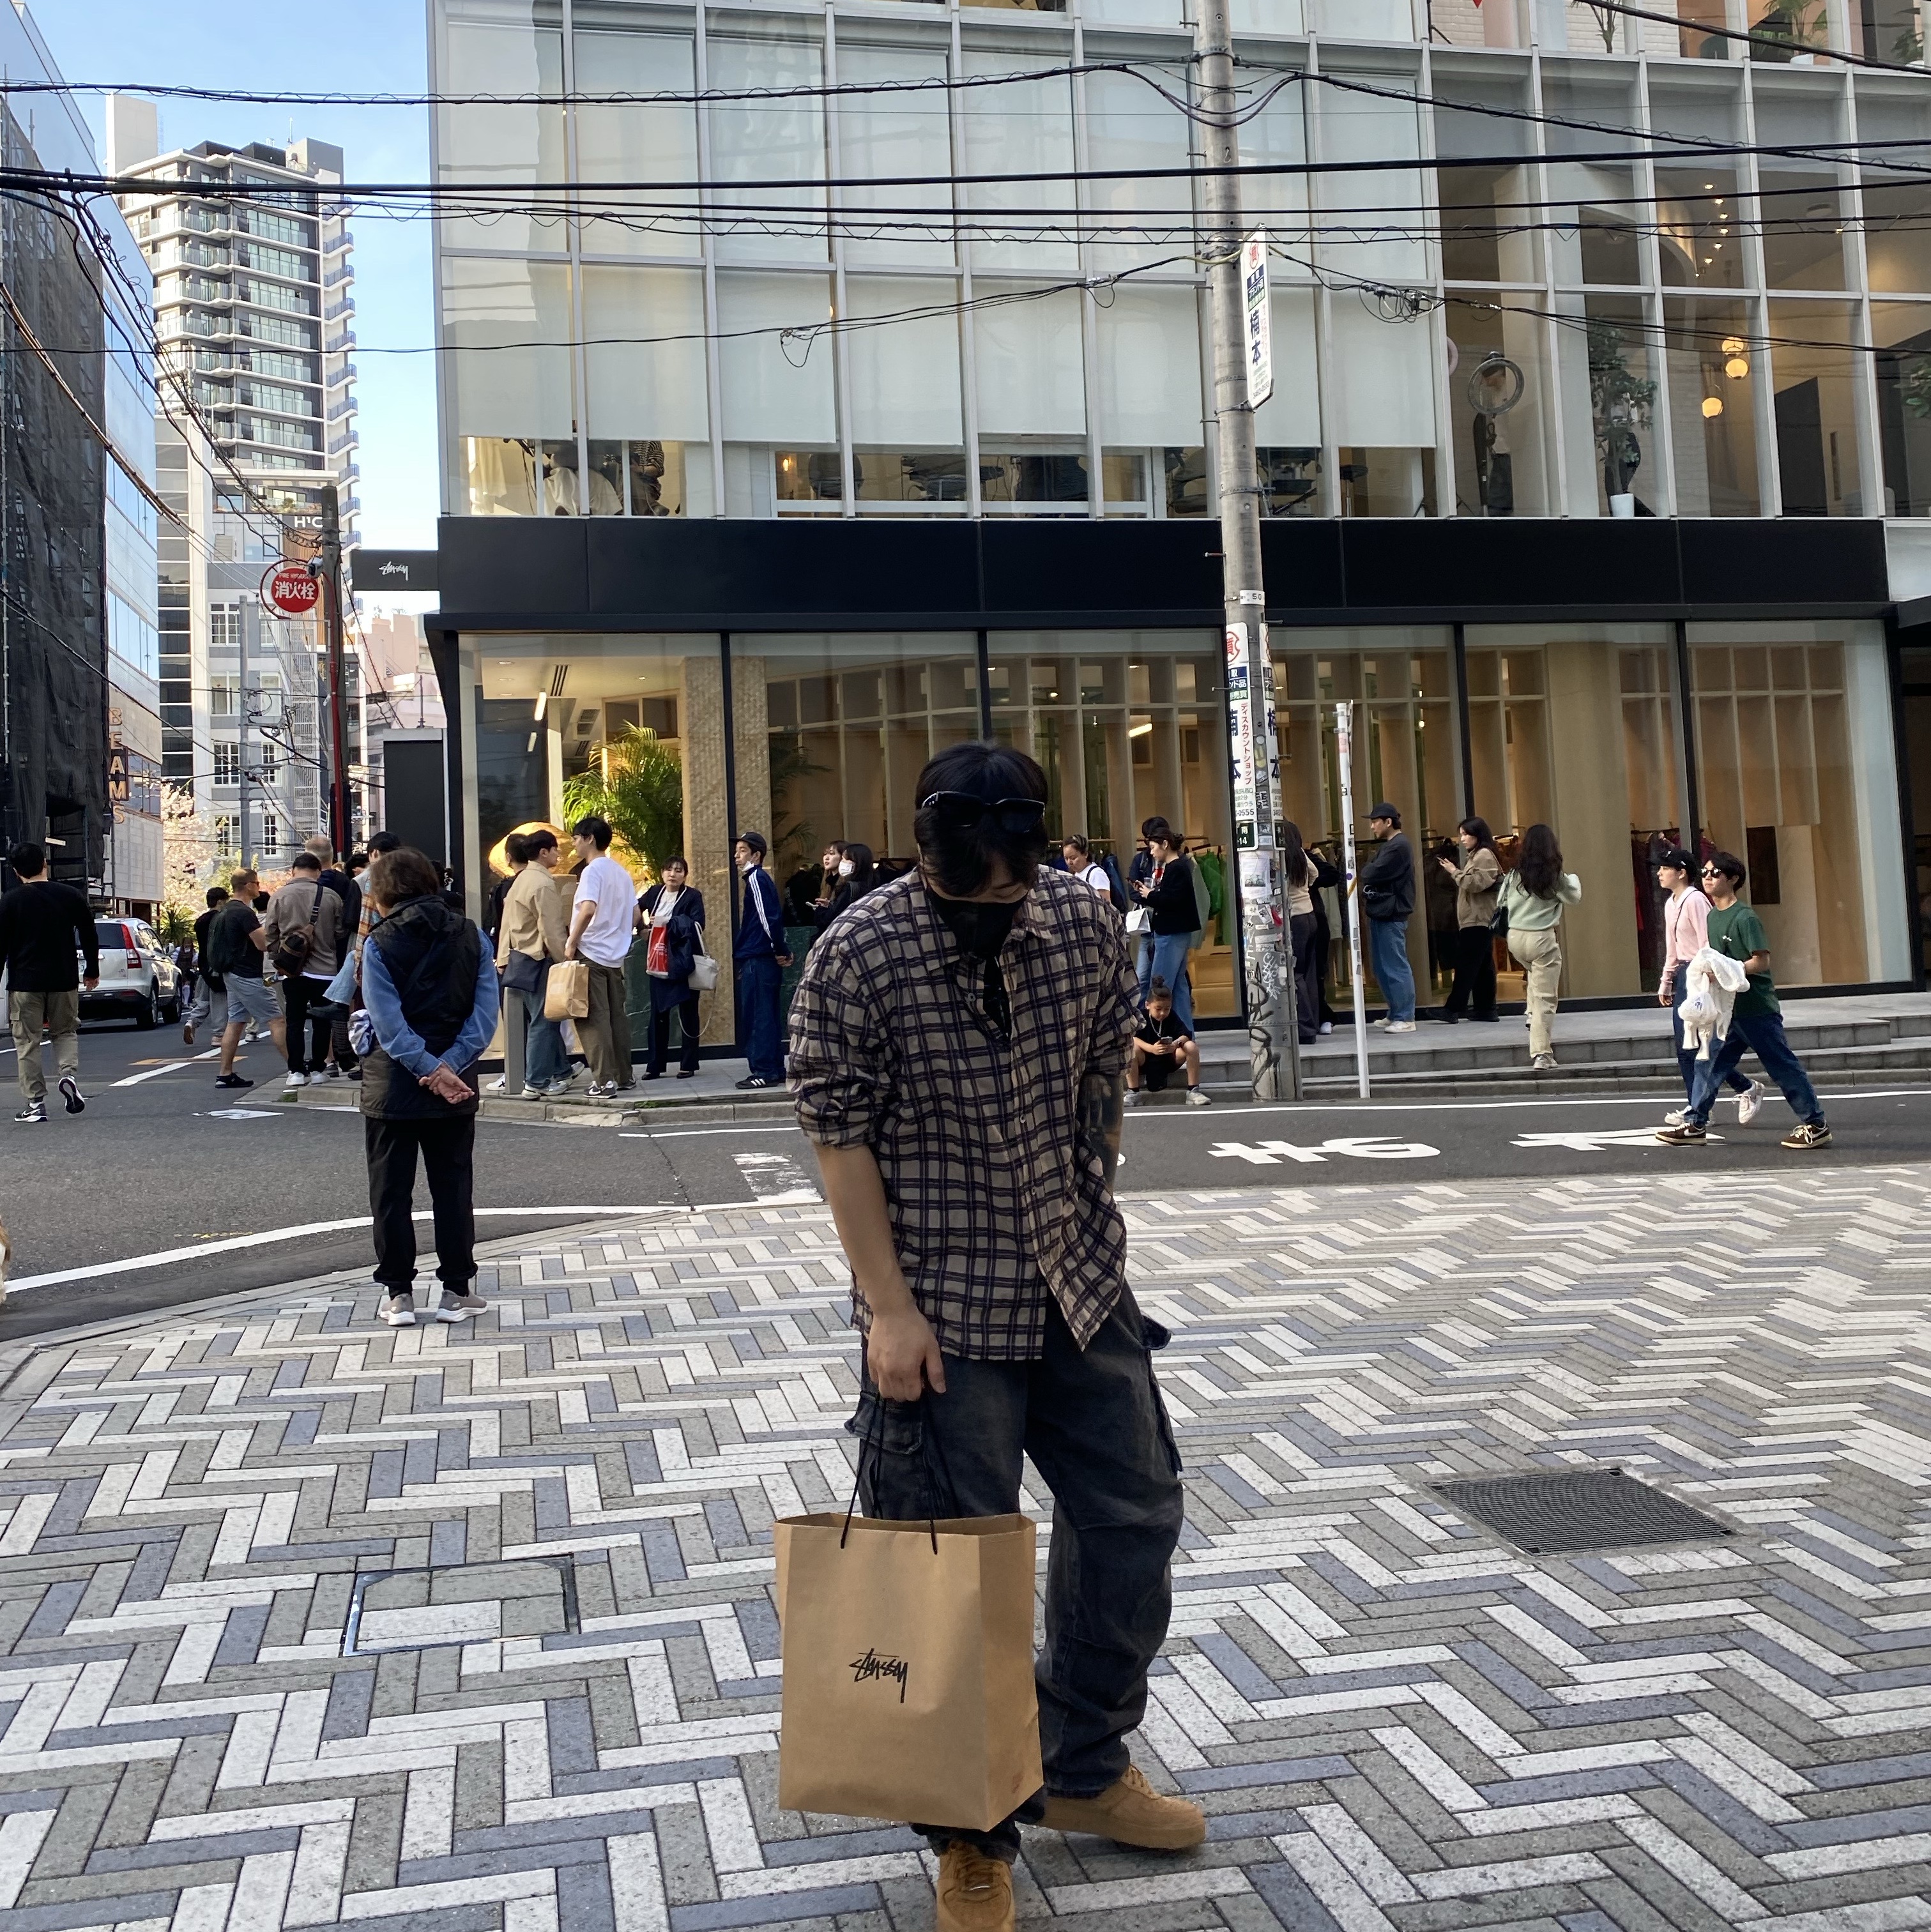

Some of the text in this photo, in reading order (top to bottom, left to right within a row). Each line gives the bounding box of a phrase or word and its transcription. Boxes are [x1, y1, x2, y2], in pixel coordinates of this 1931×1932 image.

[275, 581, 316, 600] 消火栓
[109, 707, 127, 824] BEAMS
[1240, 703, 1253, 785] ディスカウントショップ
